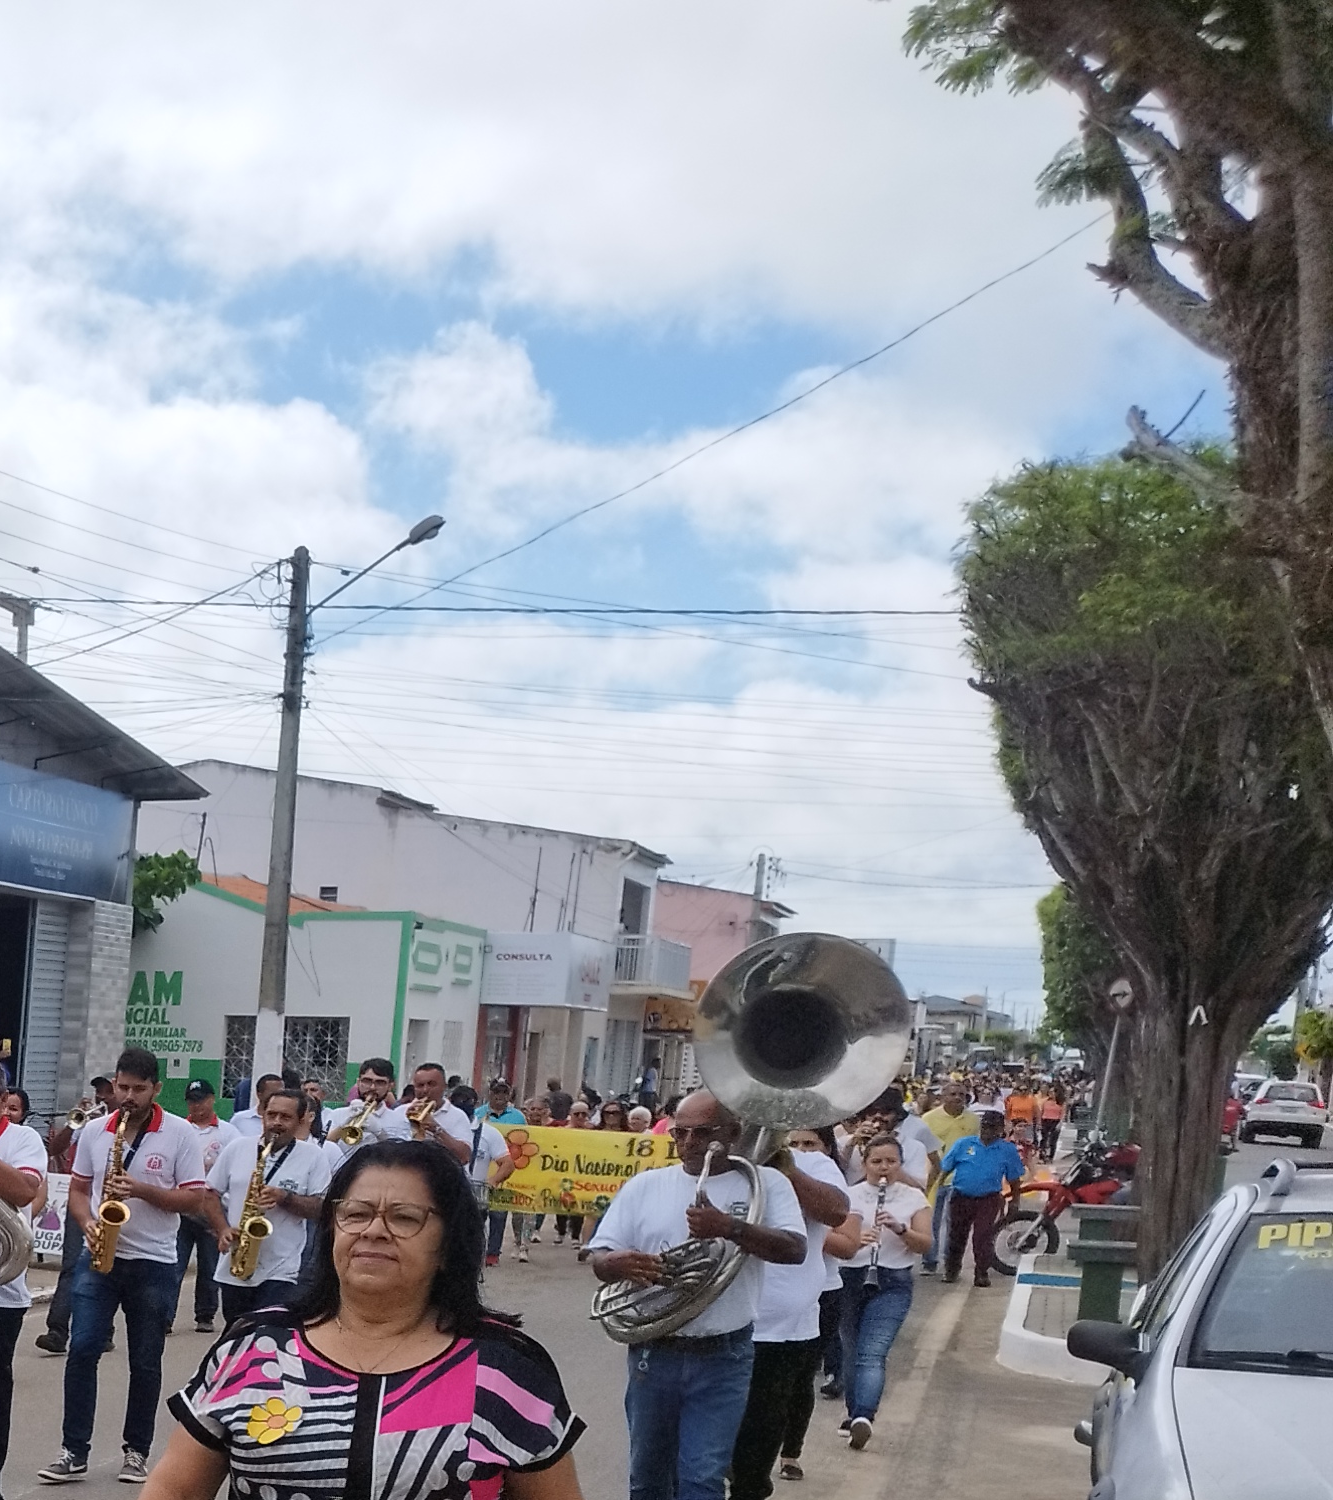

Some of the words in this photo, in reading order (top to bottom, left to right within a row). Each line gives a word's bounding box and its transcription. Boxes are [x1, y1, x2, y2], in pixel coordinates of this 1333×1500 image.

[495, 952, 553, 962] CONSULTA
[138, 1027, 187, 1039] FAMILIAR
[625, 1137, 655, 1158] 18
[540, 1154, 569, 1174] Dia
[573, 1153, 641, 1178] Nacional
